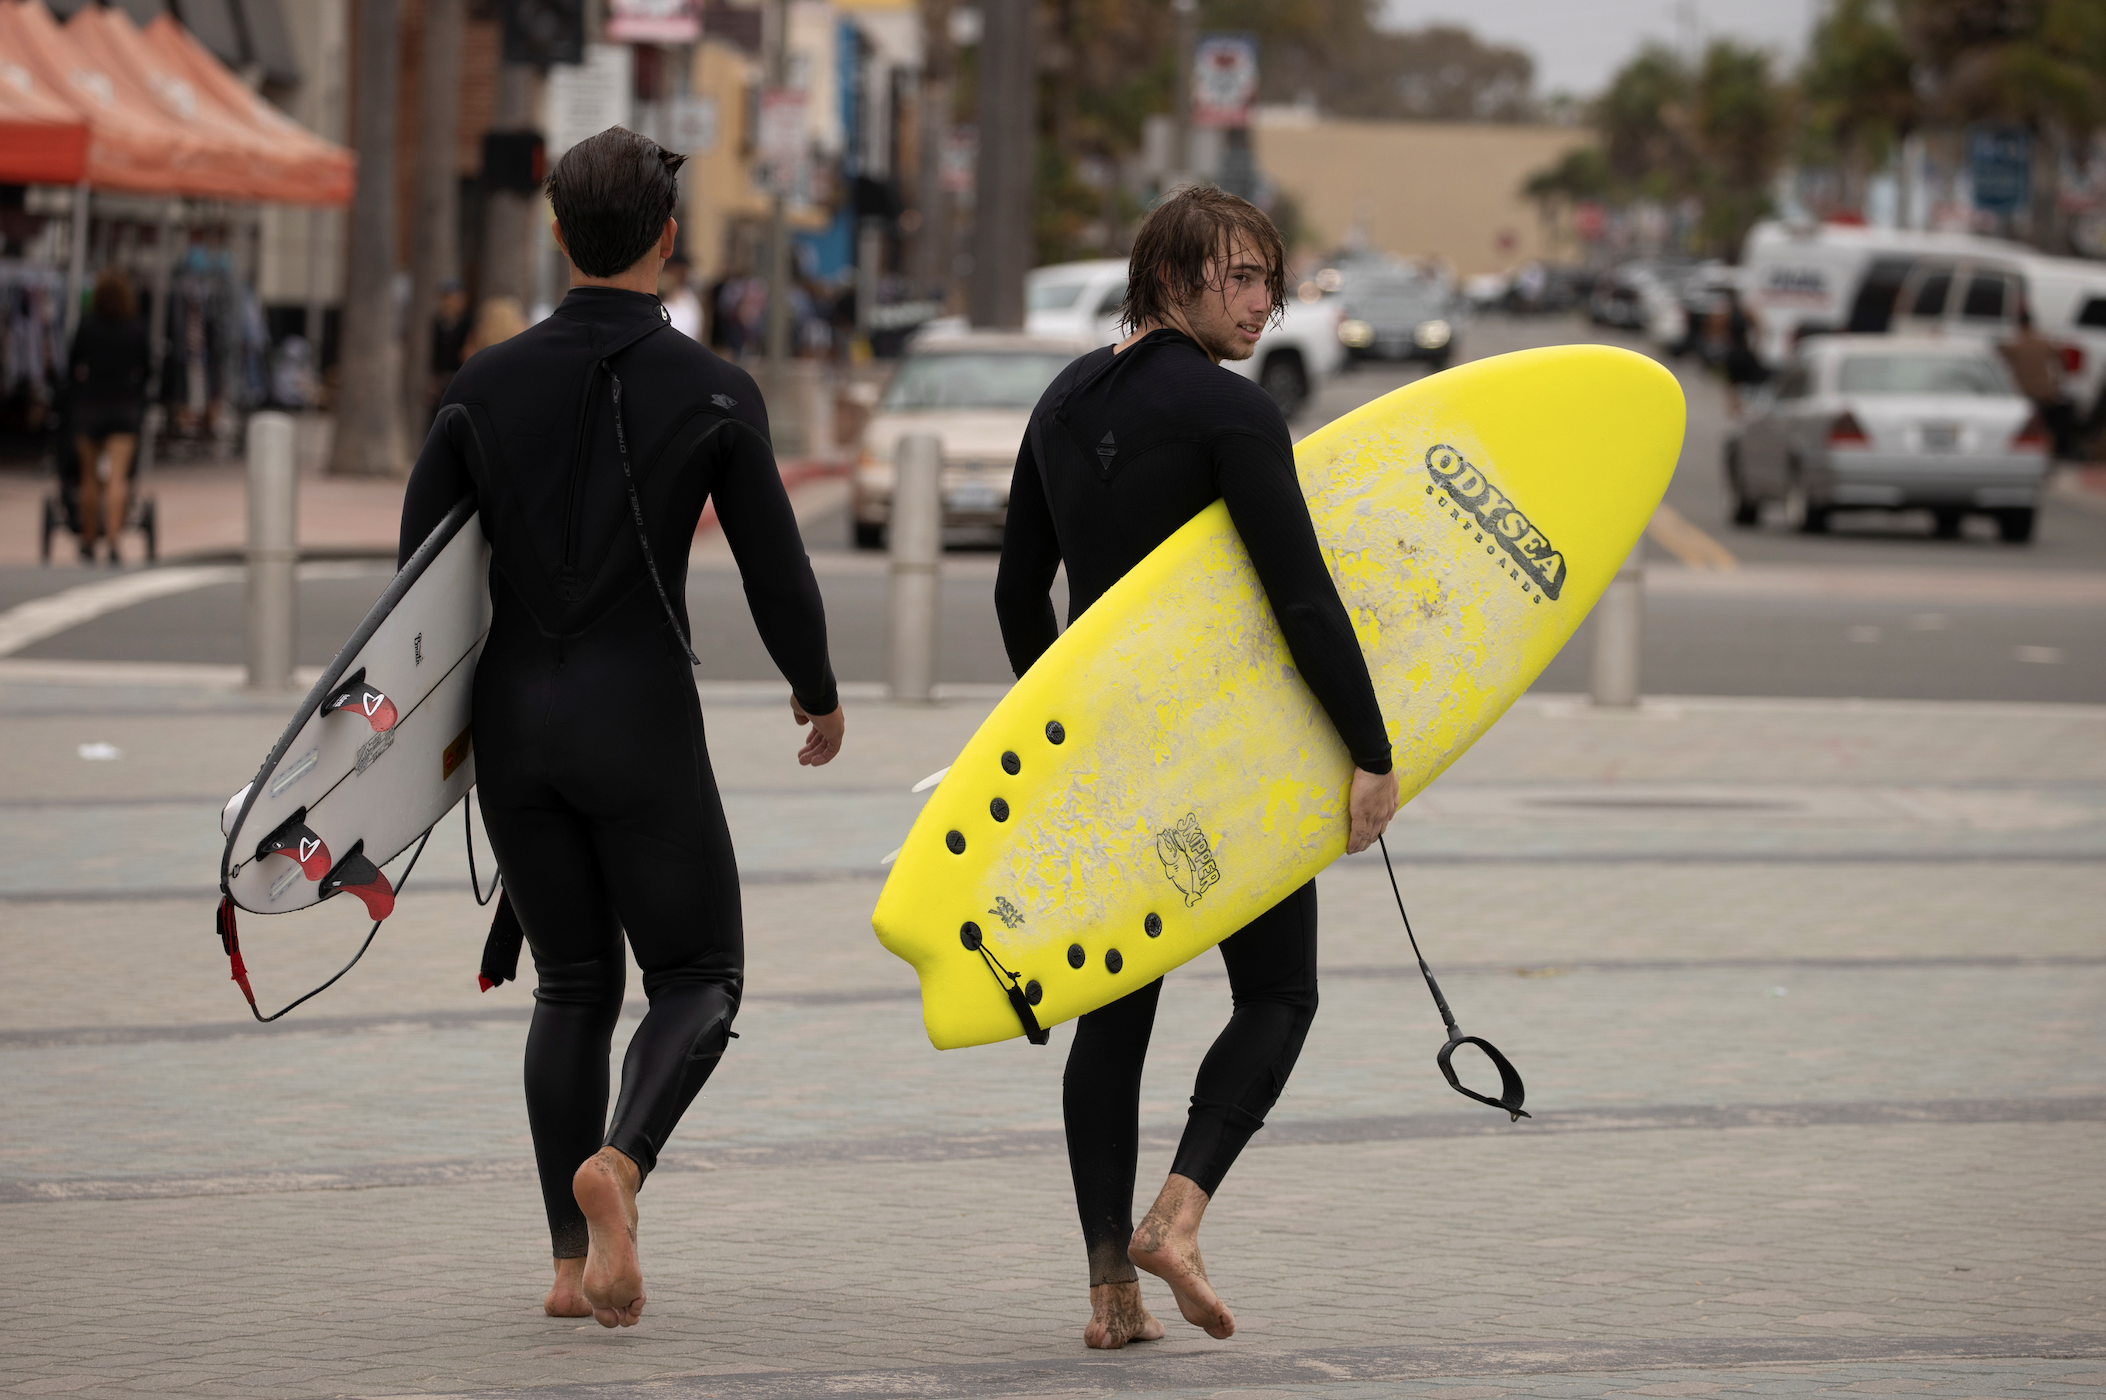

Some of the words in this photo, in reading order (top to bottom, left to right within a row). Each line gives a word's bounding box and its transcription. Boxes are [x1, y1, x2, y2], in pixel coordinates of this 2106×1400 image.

[1426, 444, 1566, 600] ODYSEA
[1426, 485, 1541, 604] SURFBOARDS
[1177, 812, 1220, 894] SKIPPER
